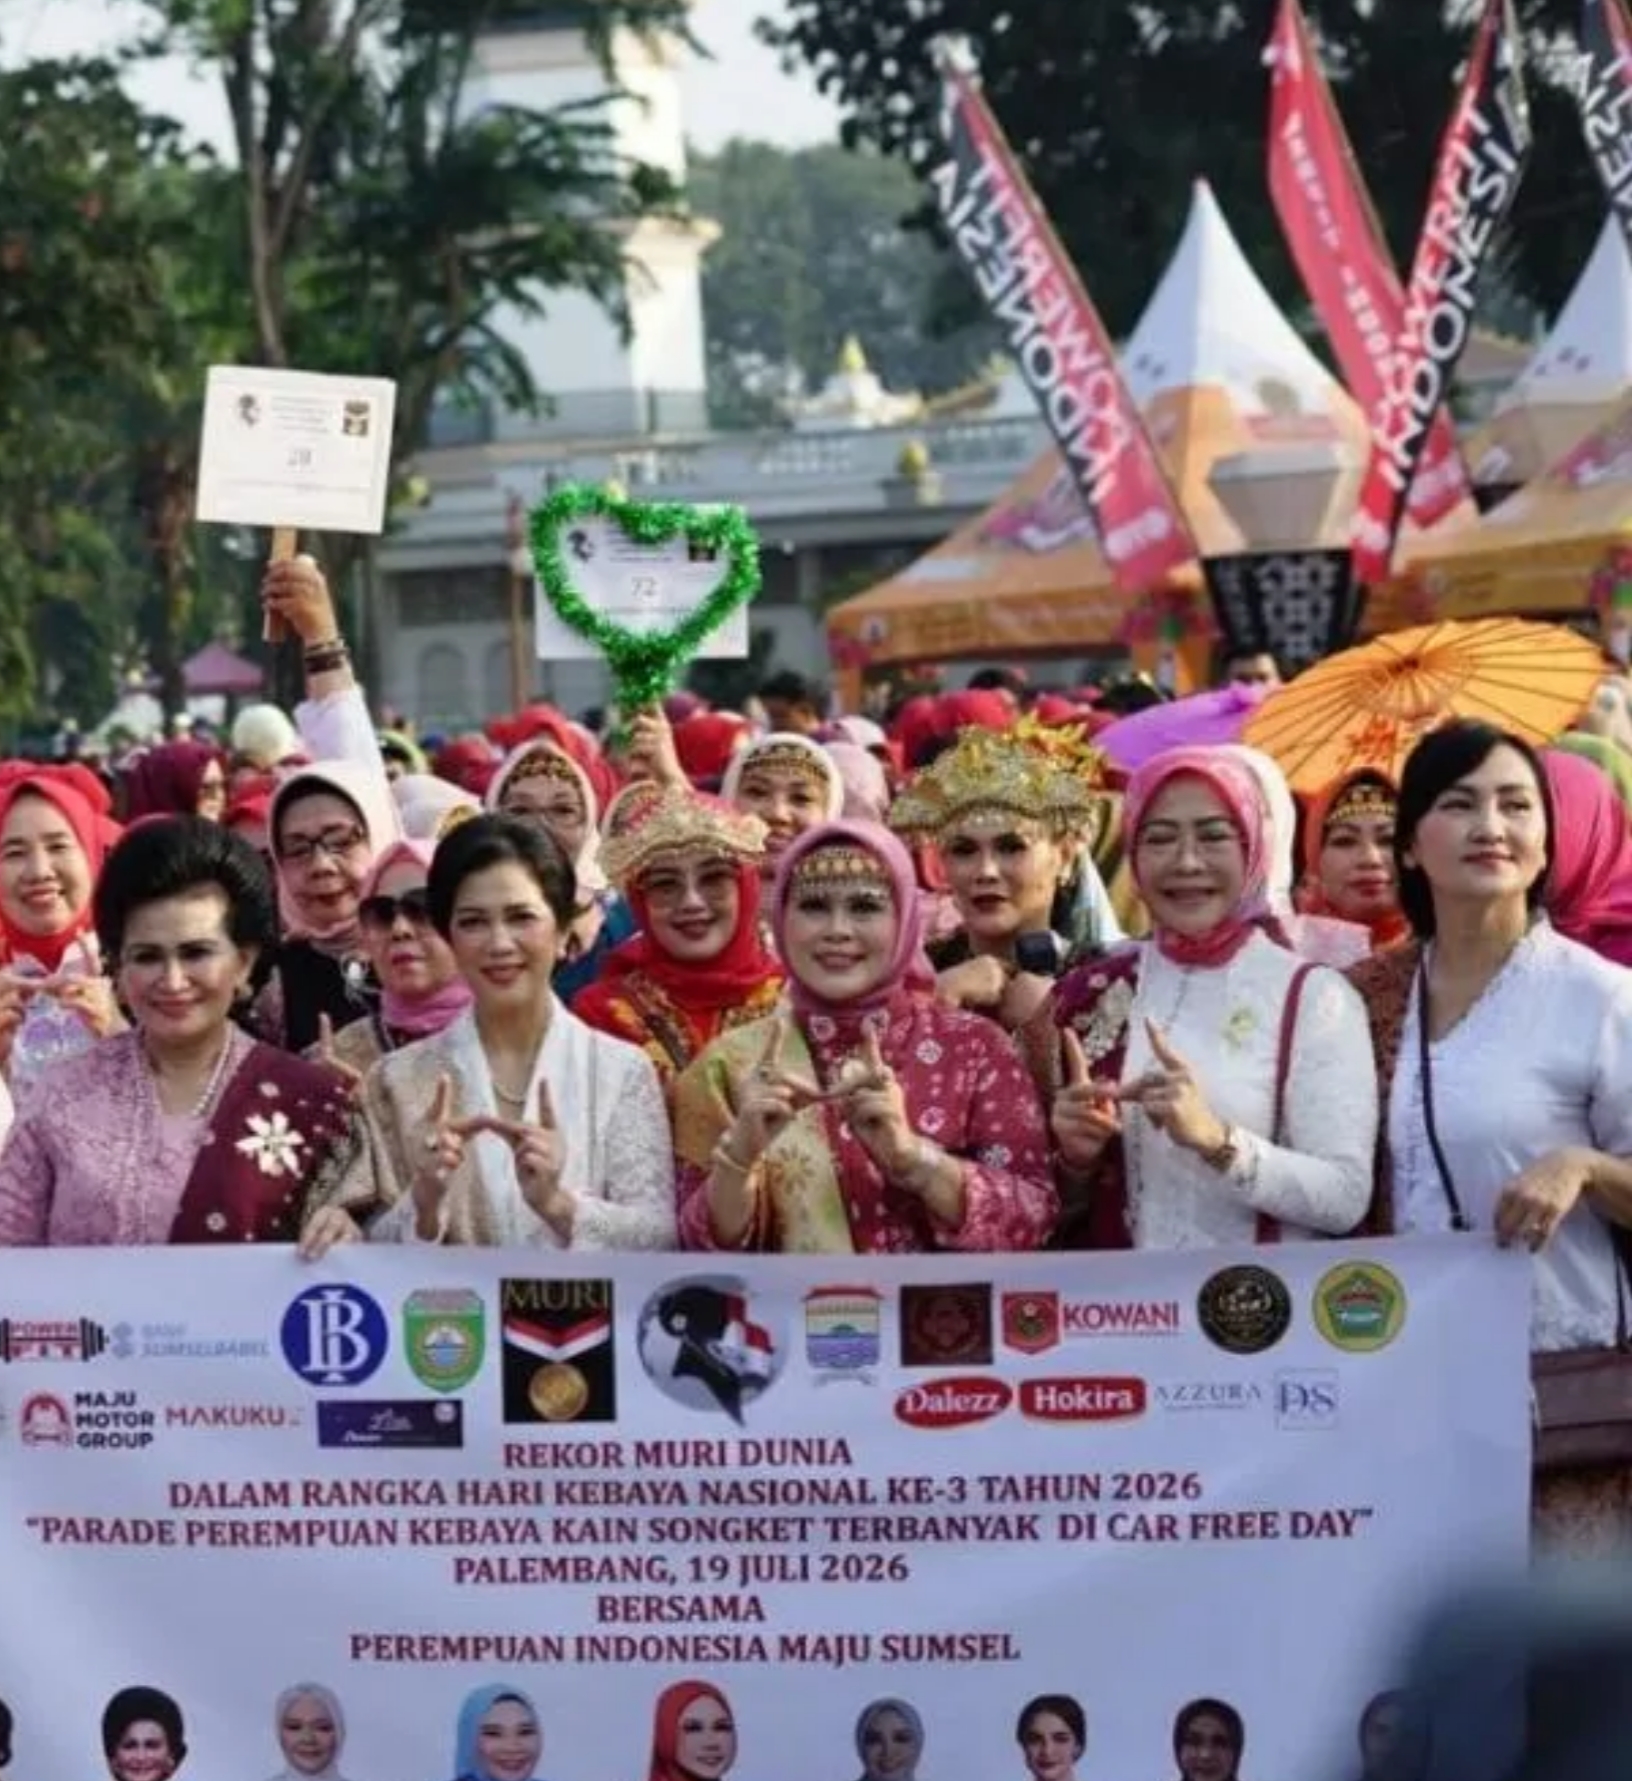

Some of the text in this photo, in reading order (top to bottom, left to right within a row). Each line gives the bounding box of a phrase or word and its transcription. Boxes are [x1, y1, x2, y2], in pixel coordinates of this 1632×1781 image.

[502, 1280, 611, 1312] MURI
[1063, 1302, 1180, 1330] KOWANI
[74, 1391, 136, 1408] MAJU
[904, 1386, 1003, 1414] Dalezz
[1034, 1385, 1135, 1413] Hokira
[1154, 1383, 1262, 1401] AZZURA
[75, 1411, 155, 1428] MOTOR
[166, 1405, 286, 1427] MAKUKU
[76, 1432, 154, 1449] GROUP
[503, 1437, 853, 1468] REKOR MURI DUNIA
[169, 1471, 1202, 1509] DALAM RANGKA HARI KEBAYA NASIONAL KE-3 TAHUN 2026
[185, 1519, 398, 1548] PEREMPUAN
[409, 1518, 542, 1546] KEBAYA
[552, 1518, 637, 1544] KAIN
[649, 1517, 815, 1543] SONGKET
[823, 1514, 1040, 1542] TERBANYAK
[1058, 1513, 1097, 1541] DI
[1107, 1513, 1180, 1542] CAR
[1190, 1510, 1280, 1541] FREE
[454, 1554, 910, 1586] PALEMBANG, 19 JULI 2026
[597, 1595, 766, 1623] BERSAMA
[350, 1633, 1021, 1668] PEREMPUAN INDONESIA MAJU SUMSEL
